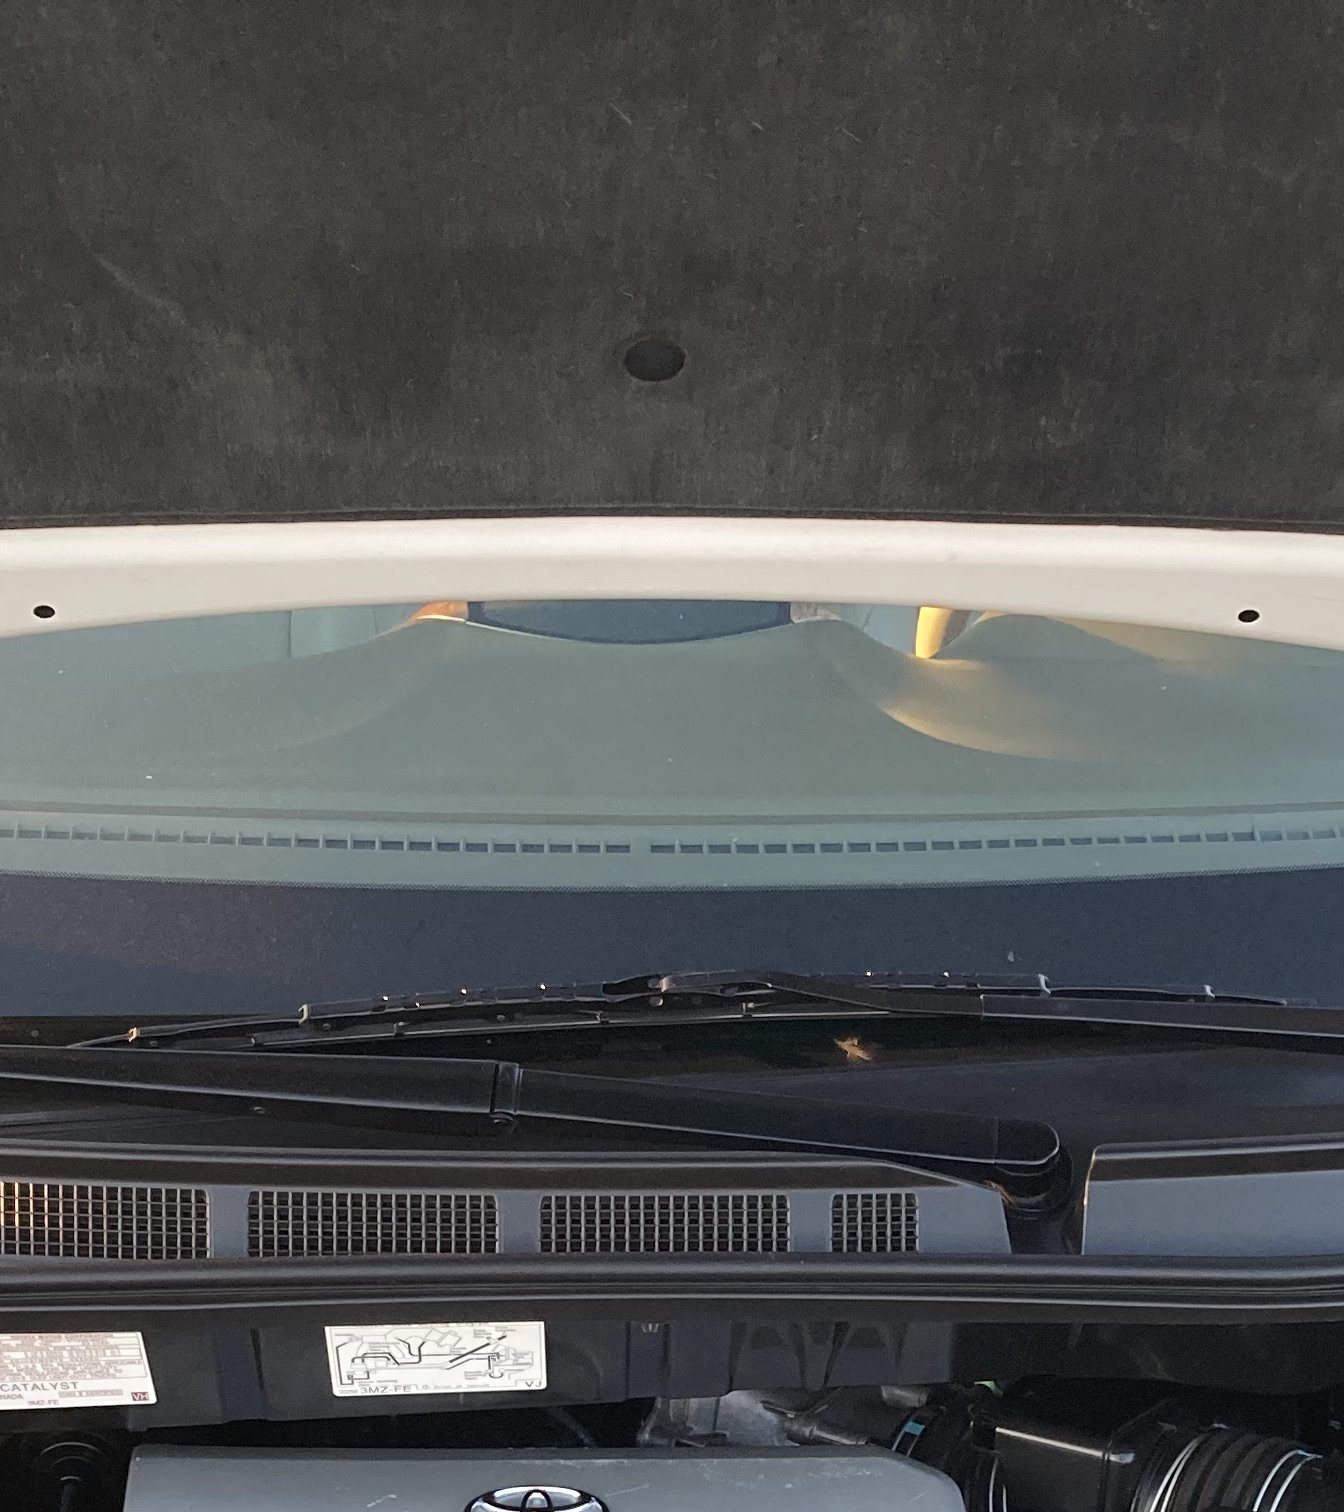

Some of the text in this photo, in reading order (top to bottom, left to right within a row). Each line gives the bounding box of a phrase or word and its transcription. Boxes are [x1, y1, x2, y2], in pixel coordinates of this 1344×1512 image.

[0, 1381, 79, 1392] CATALYST
[360, 1385, 412, 1394] 3MZ-FE
[132, 1393, 150, 1401] VH
